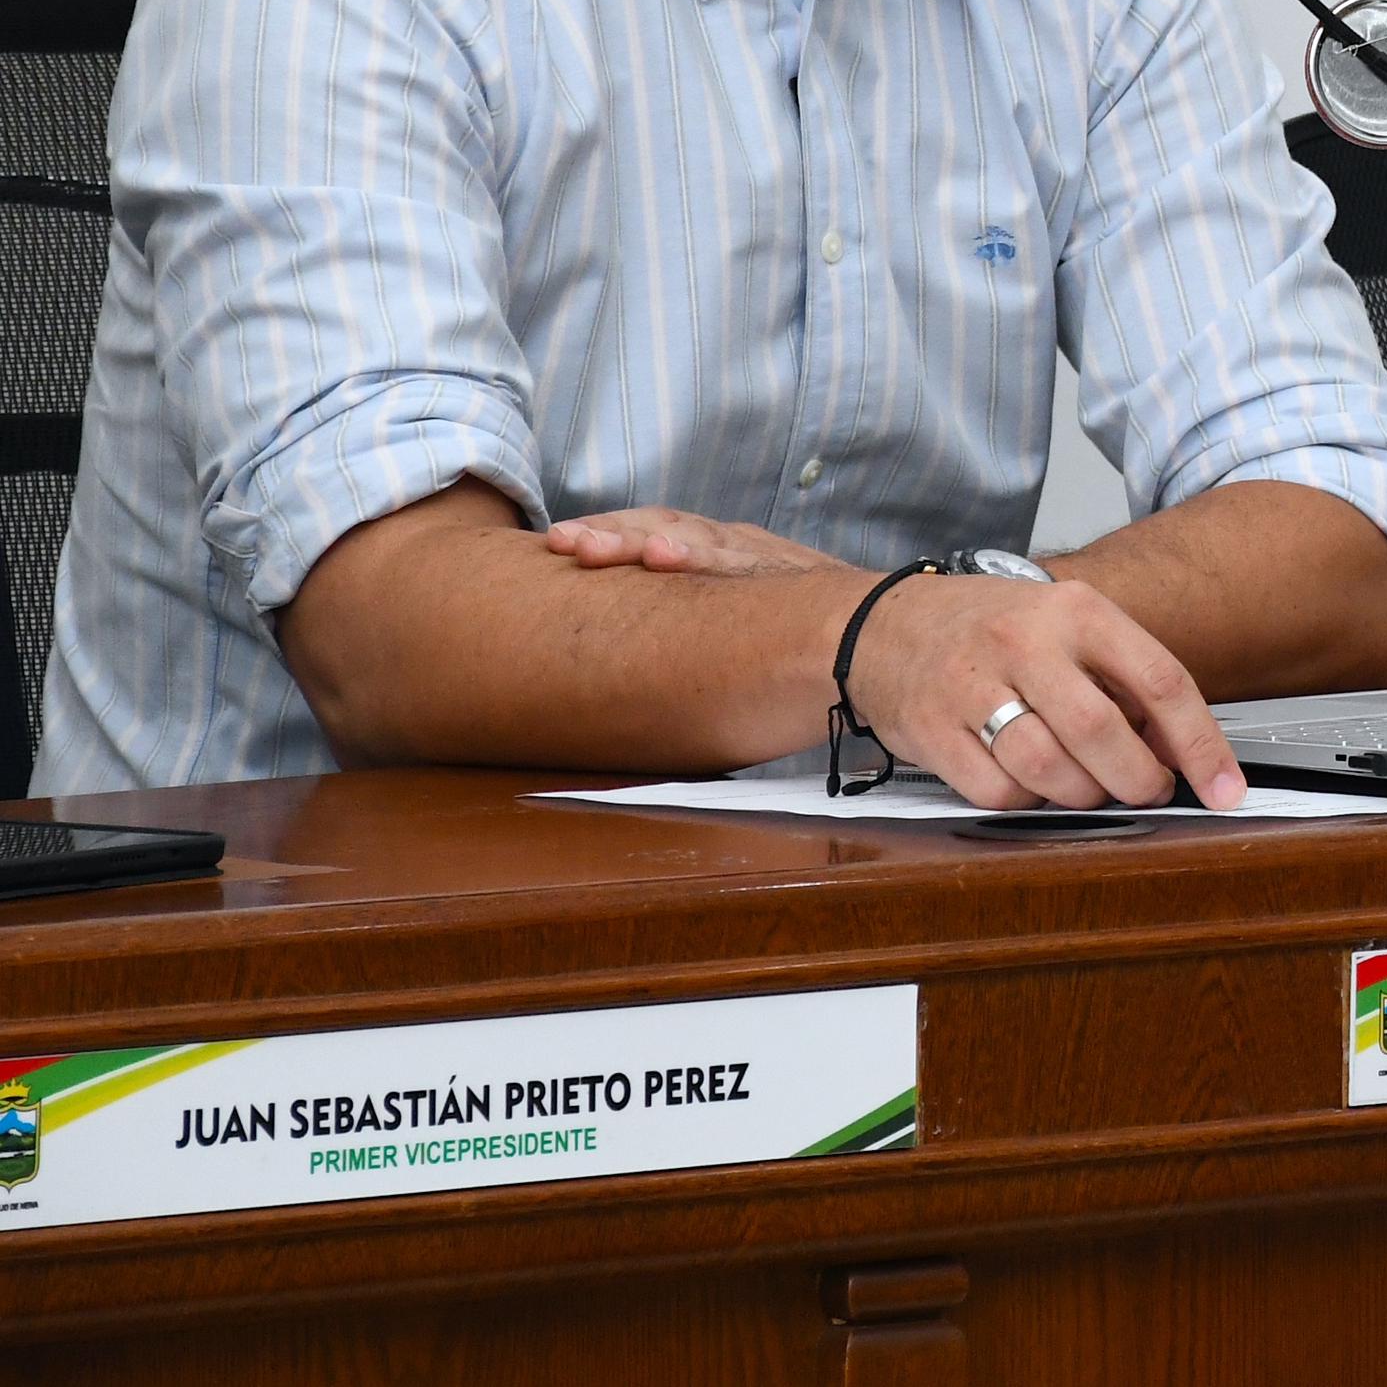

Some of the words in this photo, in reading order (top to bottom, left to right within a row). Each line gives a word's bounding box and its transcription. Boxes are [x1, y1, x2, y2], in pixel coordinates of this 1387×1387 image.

[175, 1102, 276, 1149] JUAN
[289, 1074, 492, 1138] SEBASTIÁN
[505, 1072, 632, 1120] PRIETO
[644, 1062, 750, 1108] PEREZ
[310, 1144, 398, 1175] PRIMER
[405, 1127, 597, 1166] VICEPRESIDENTE
